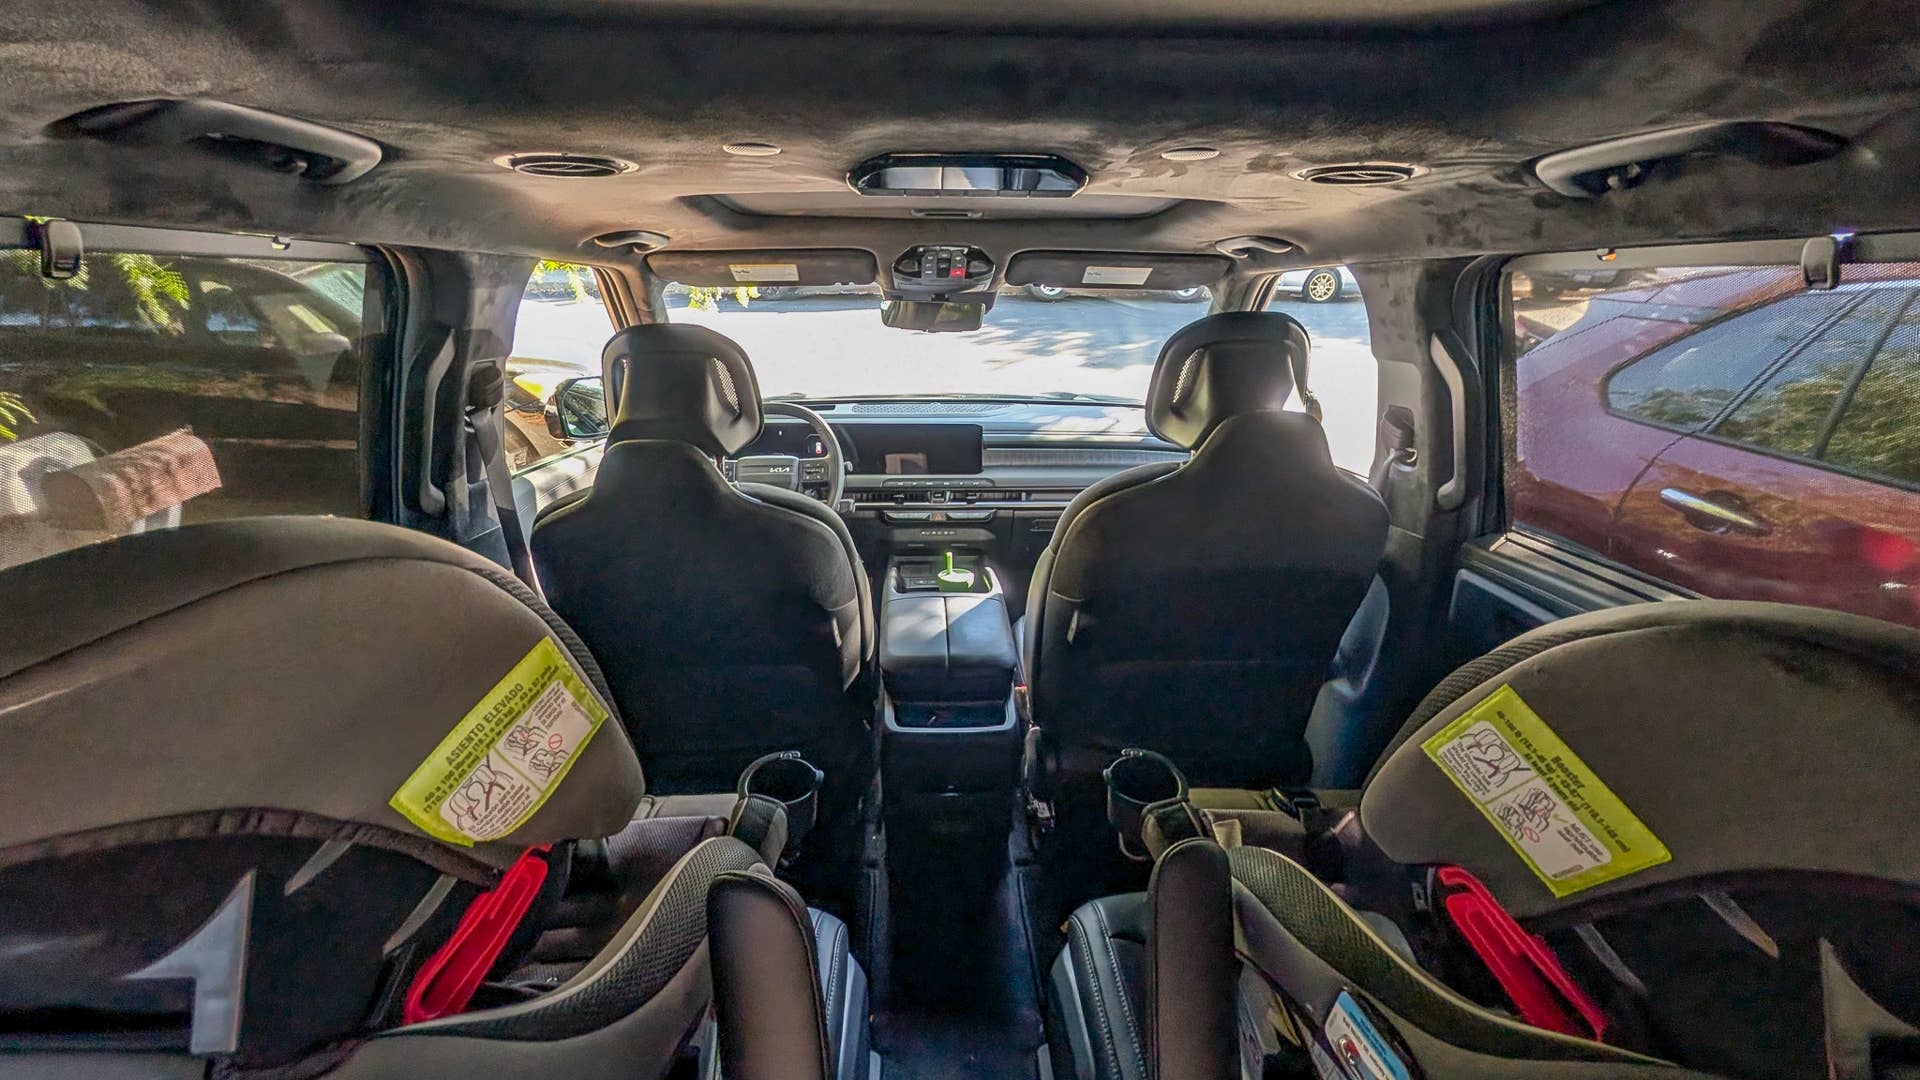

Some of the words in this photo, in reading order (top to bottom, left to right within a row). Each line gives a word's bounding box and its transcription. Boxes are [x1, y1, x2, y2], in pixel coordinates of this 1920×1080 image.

[443, 721, 486, 765] ASIENTO
[482, 681, 525, 724] ELEVADO
[1550, 753, 1585, 791] Booster
